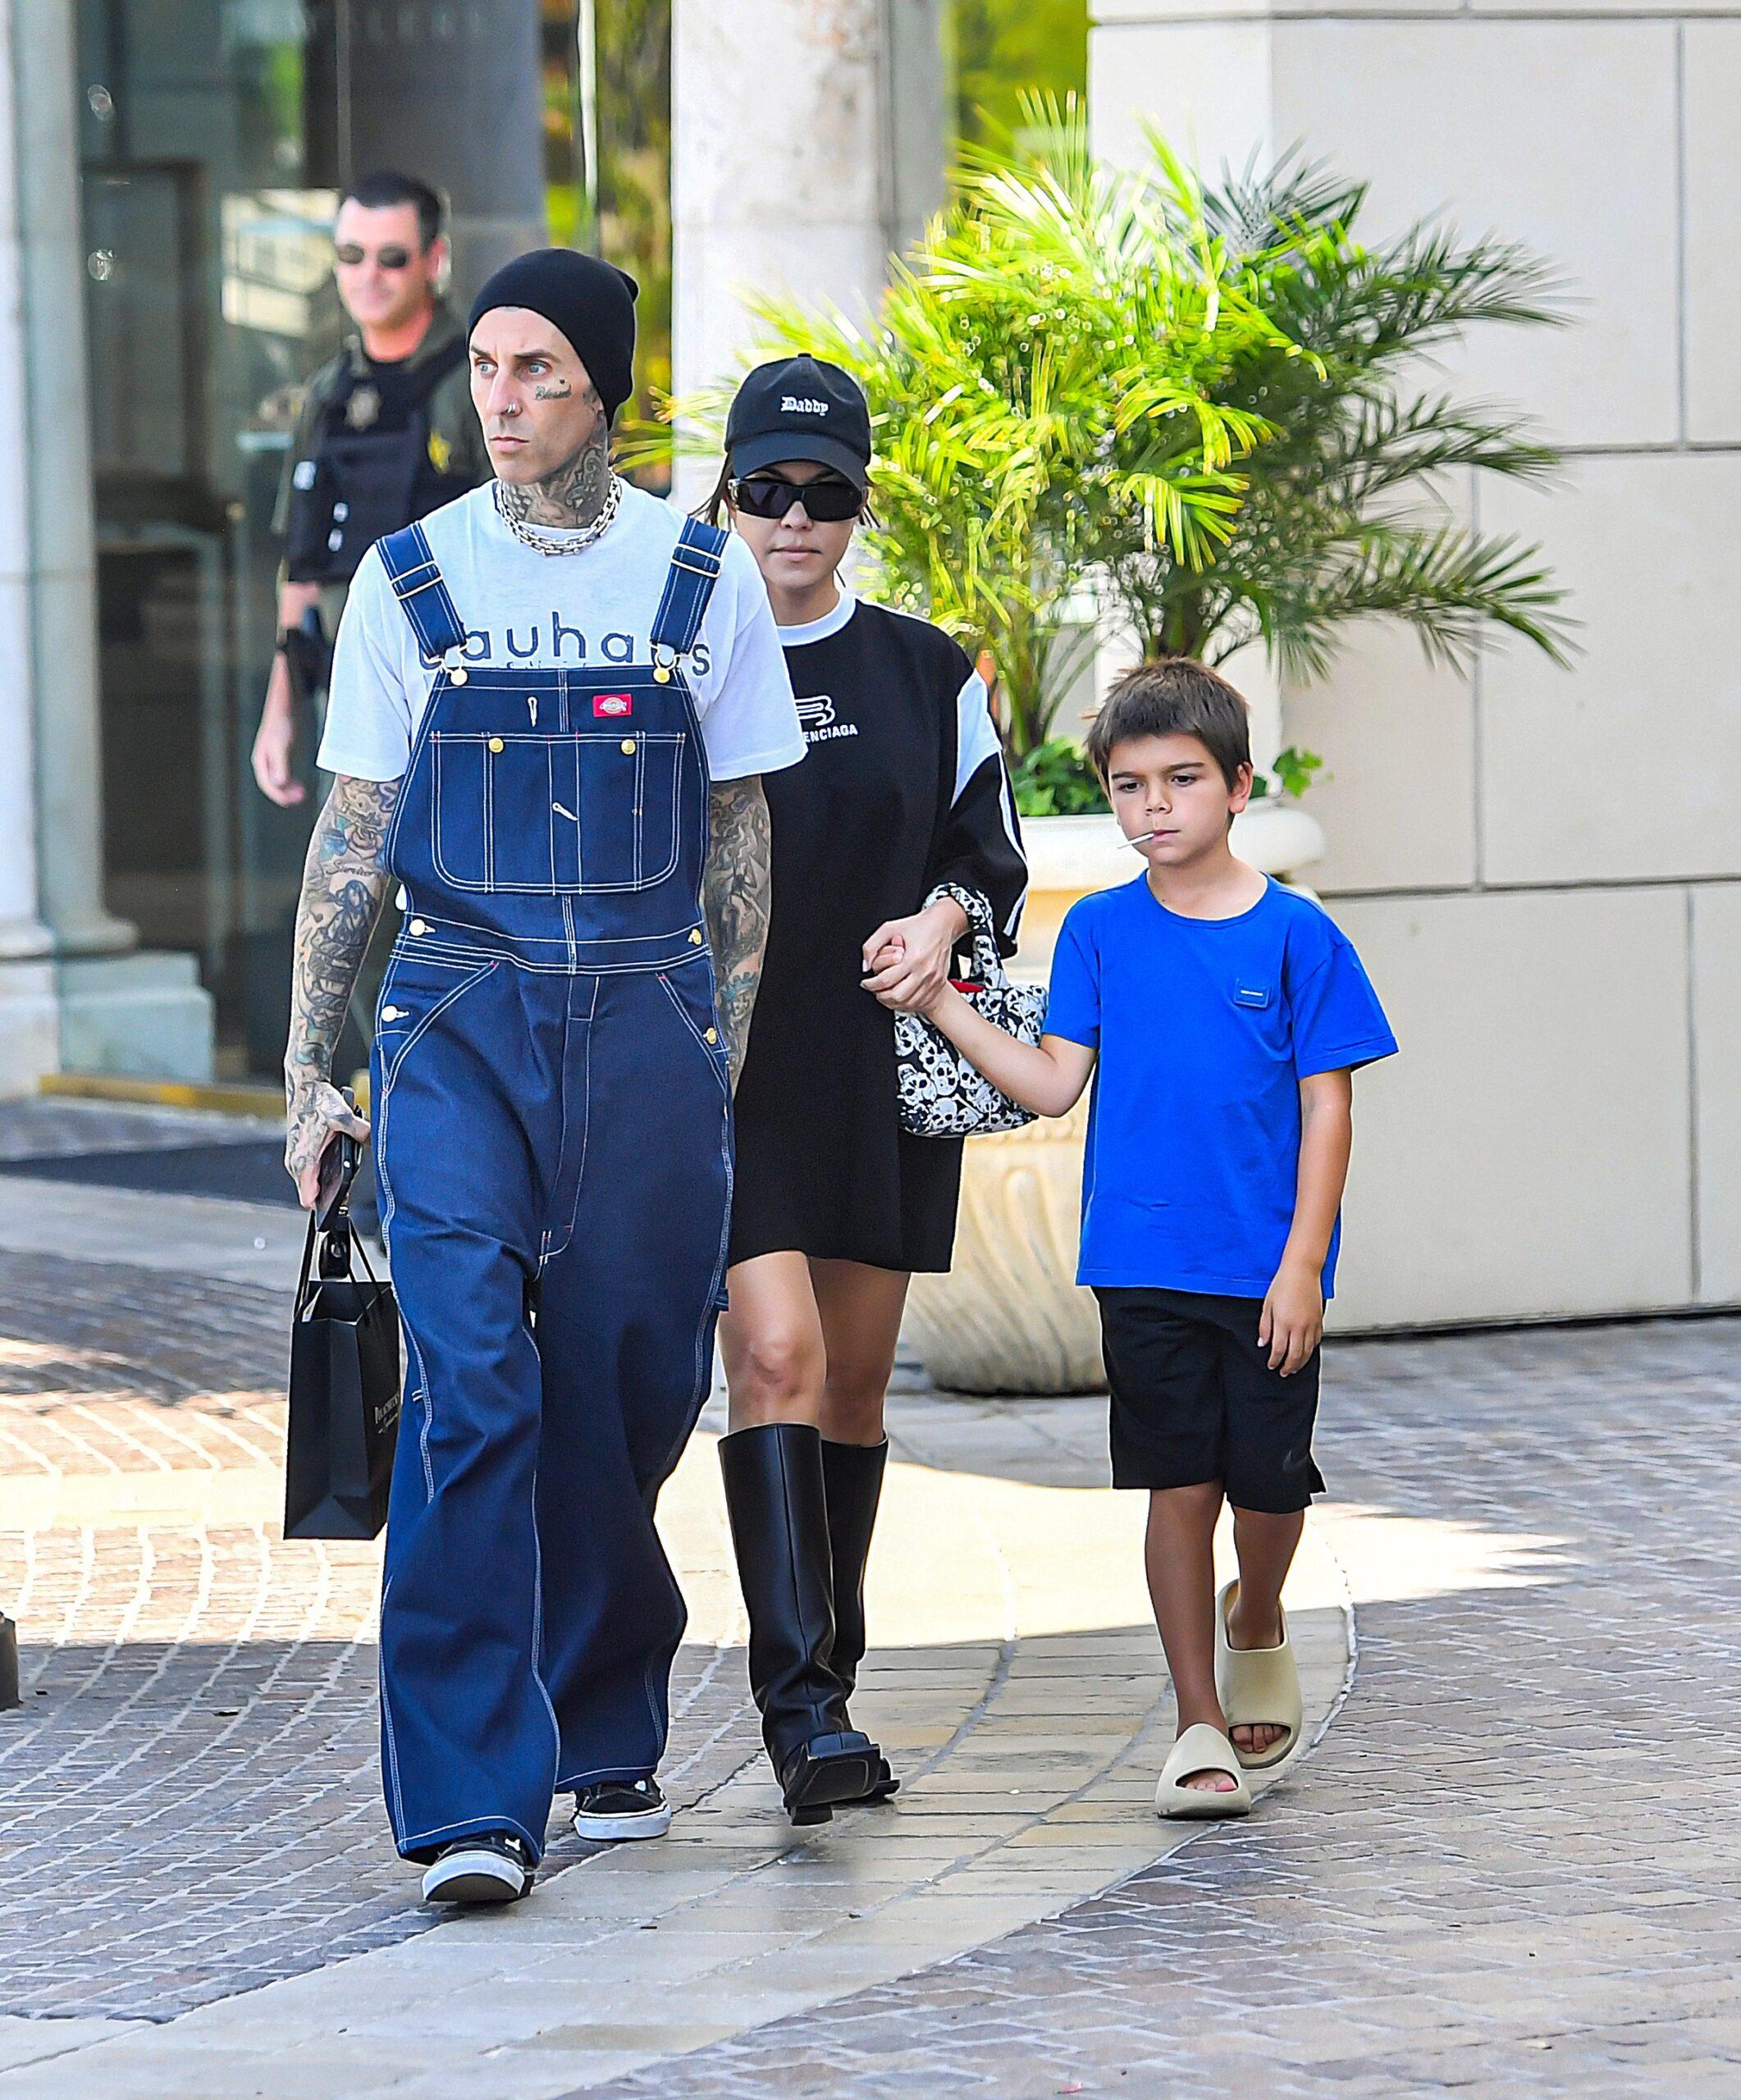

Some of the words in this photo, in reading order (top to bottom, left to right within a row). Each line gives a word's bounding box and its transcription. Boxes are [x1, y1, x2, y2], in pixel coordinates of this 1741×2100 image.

[780, 395, 829, 417] Daddy
[419, 612, 711, 677] auhas
[802, 724, 858, 743] ENCIAGA
